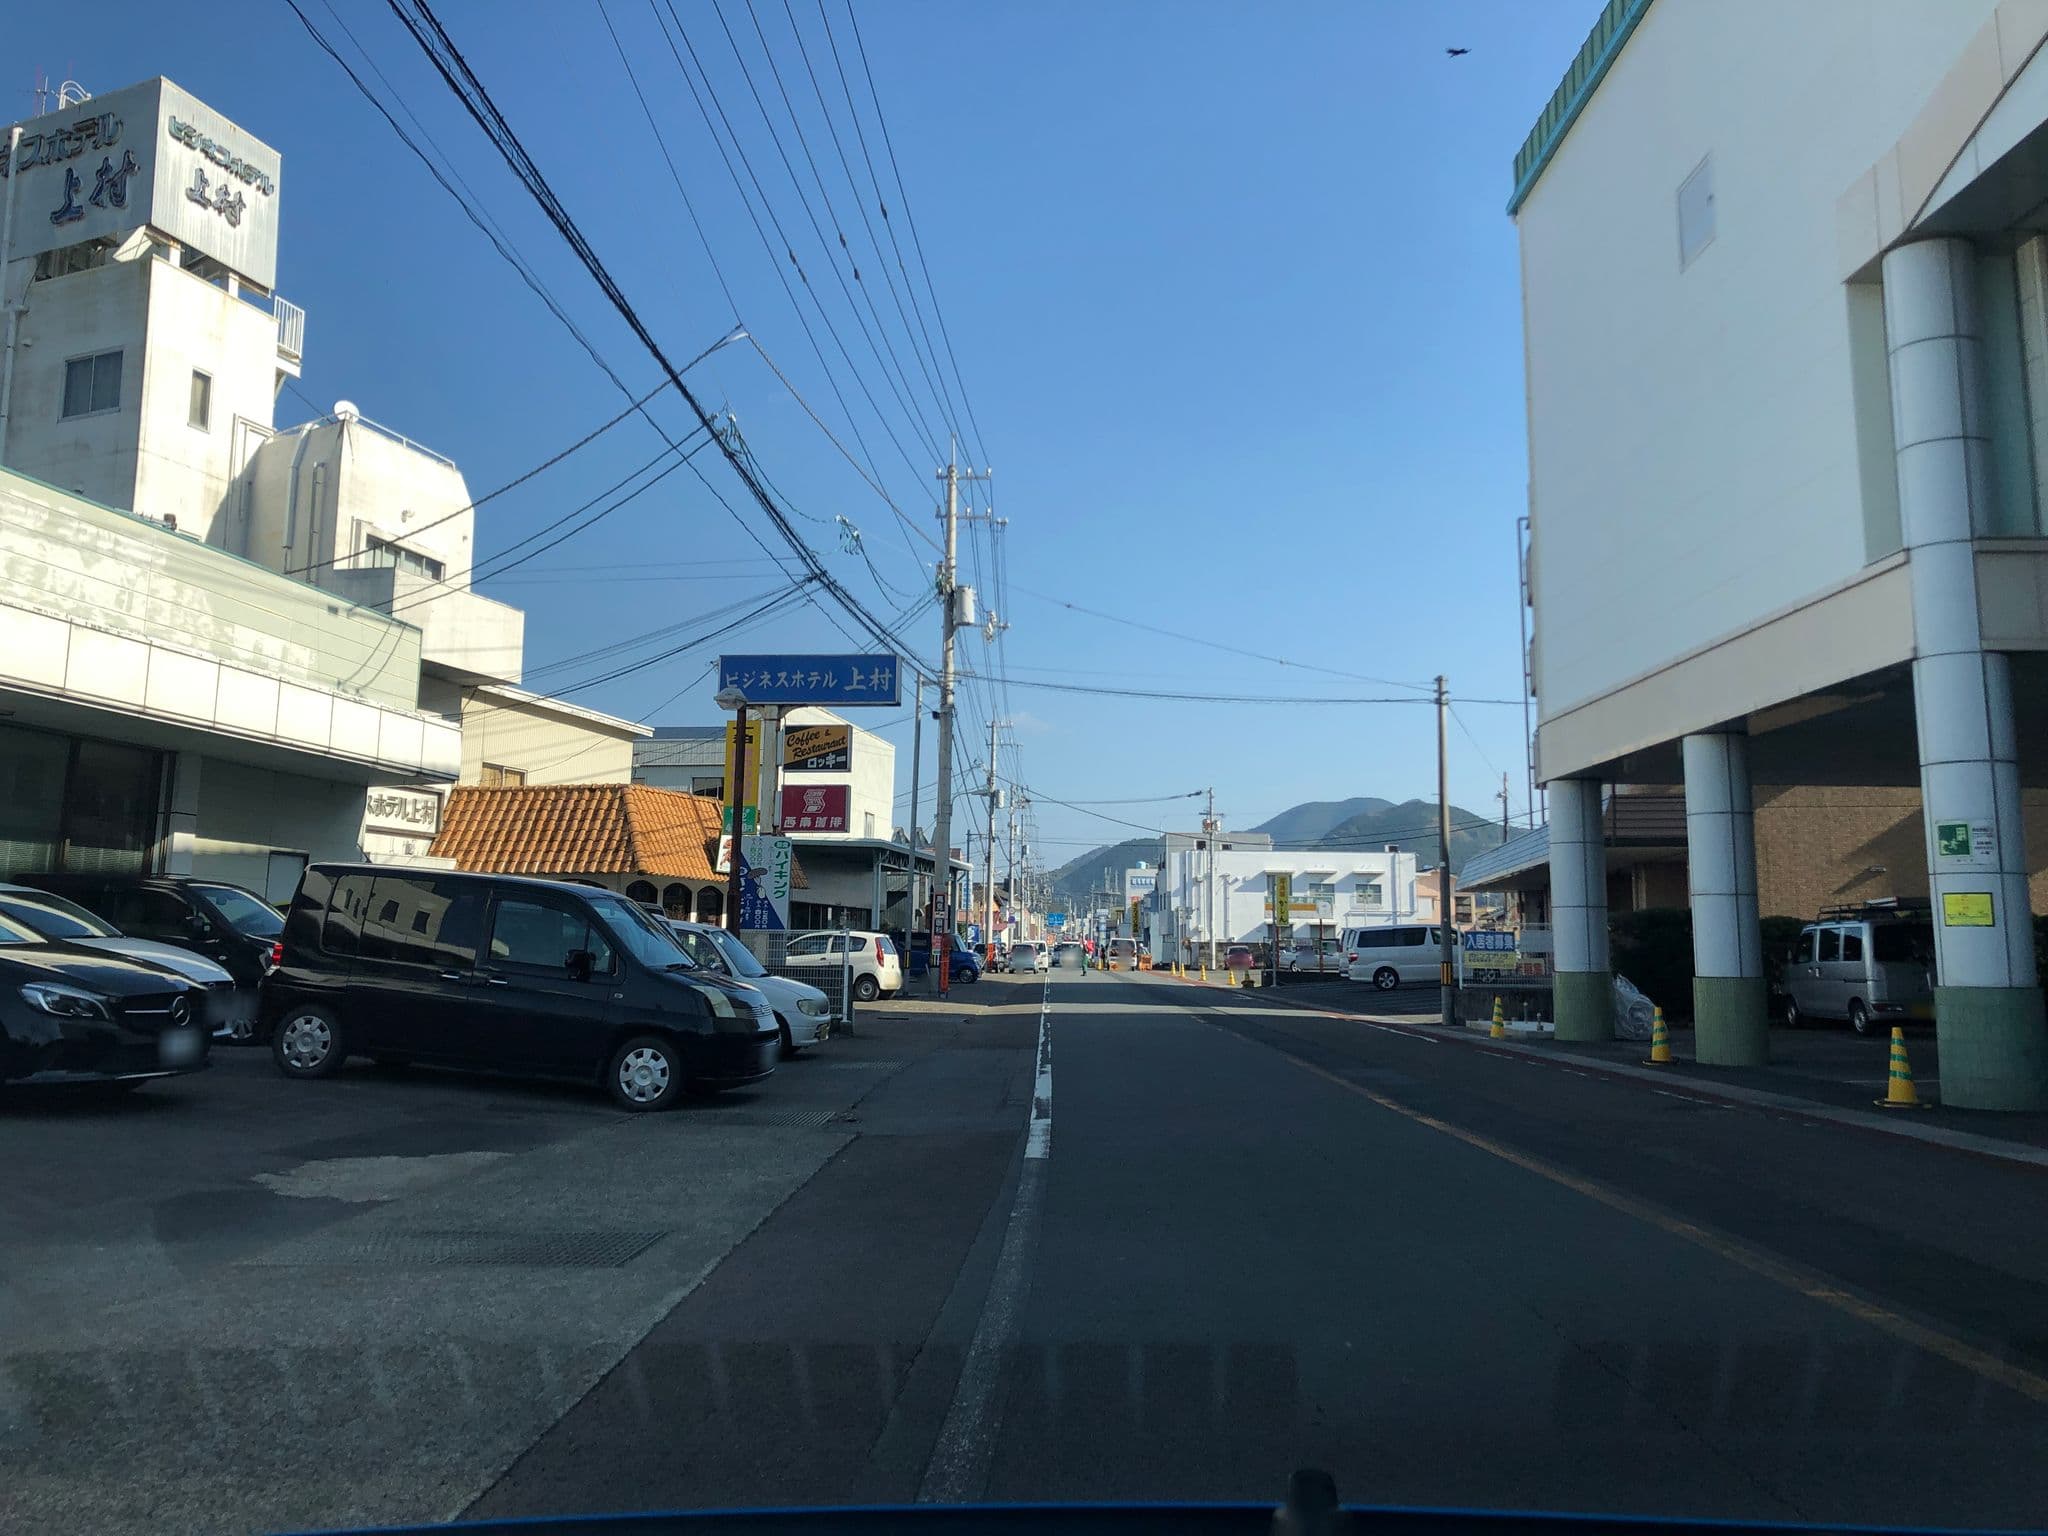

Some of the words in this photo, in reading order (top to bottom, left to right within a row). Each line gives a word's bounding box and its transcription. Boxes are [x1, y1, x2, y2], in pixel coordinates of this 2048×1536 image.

[50, 150, 141, 226] 上村
[185, 167, 248, 228] 上村
[844, 666, 893, 692] 上村
[786, 731, 821, 748] Coffee
[792, 736, 848, 760] Restaurant
[807, 753, 847, 769] ロッキー
[1466, 934, 1514, 950] 入居者募集
